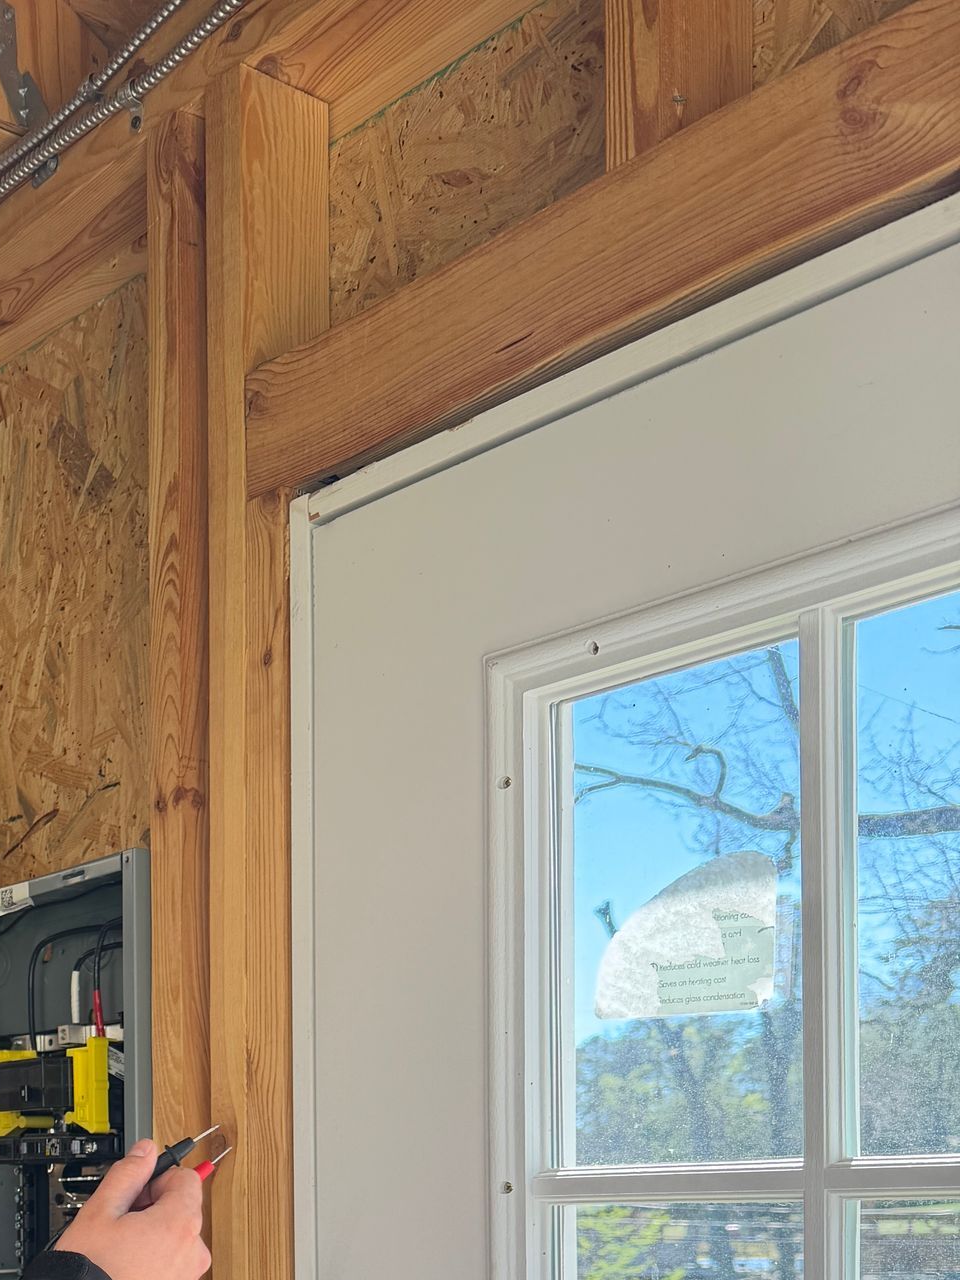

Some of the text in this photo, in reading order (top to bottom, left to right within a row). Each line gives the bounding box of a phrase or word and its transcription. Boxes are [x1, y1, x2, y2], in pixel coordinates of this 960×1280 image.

[686, 959, 701, 970] cold
[702, 957, 729, 968] weather
[730, 956, 746, 966] heat
[747, 955, 760, 964] loss
[658, 979, 677, 989] Saves
[713, 976, 727, 984] cost
[684, 994, 702, 1006] glass
[702, 991, 746, 1002] condensation
